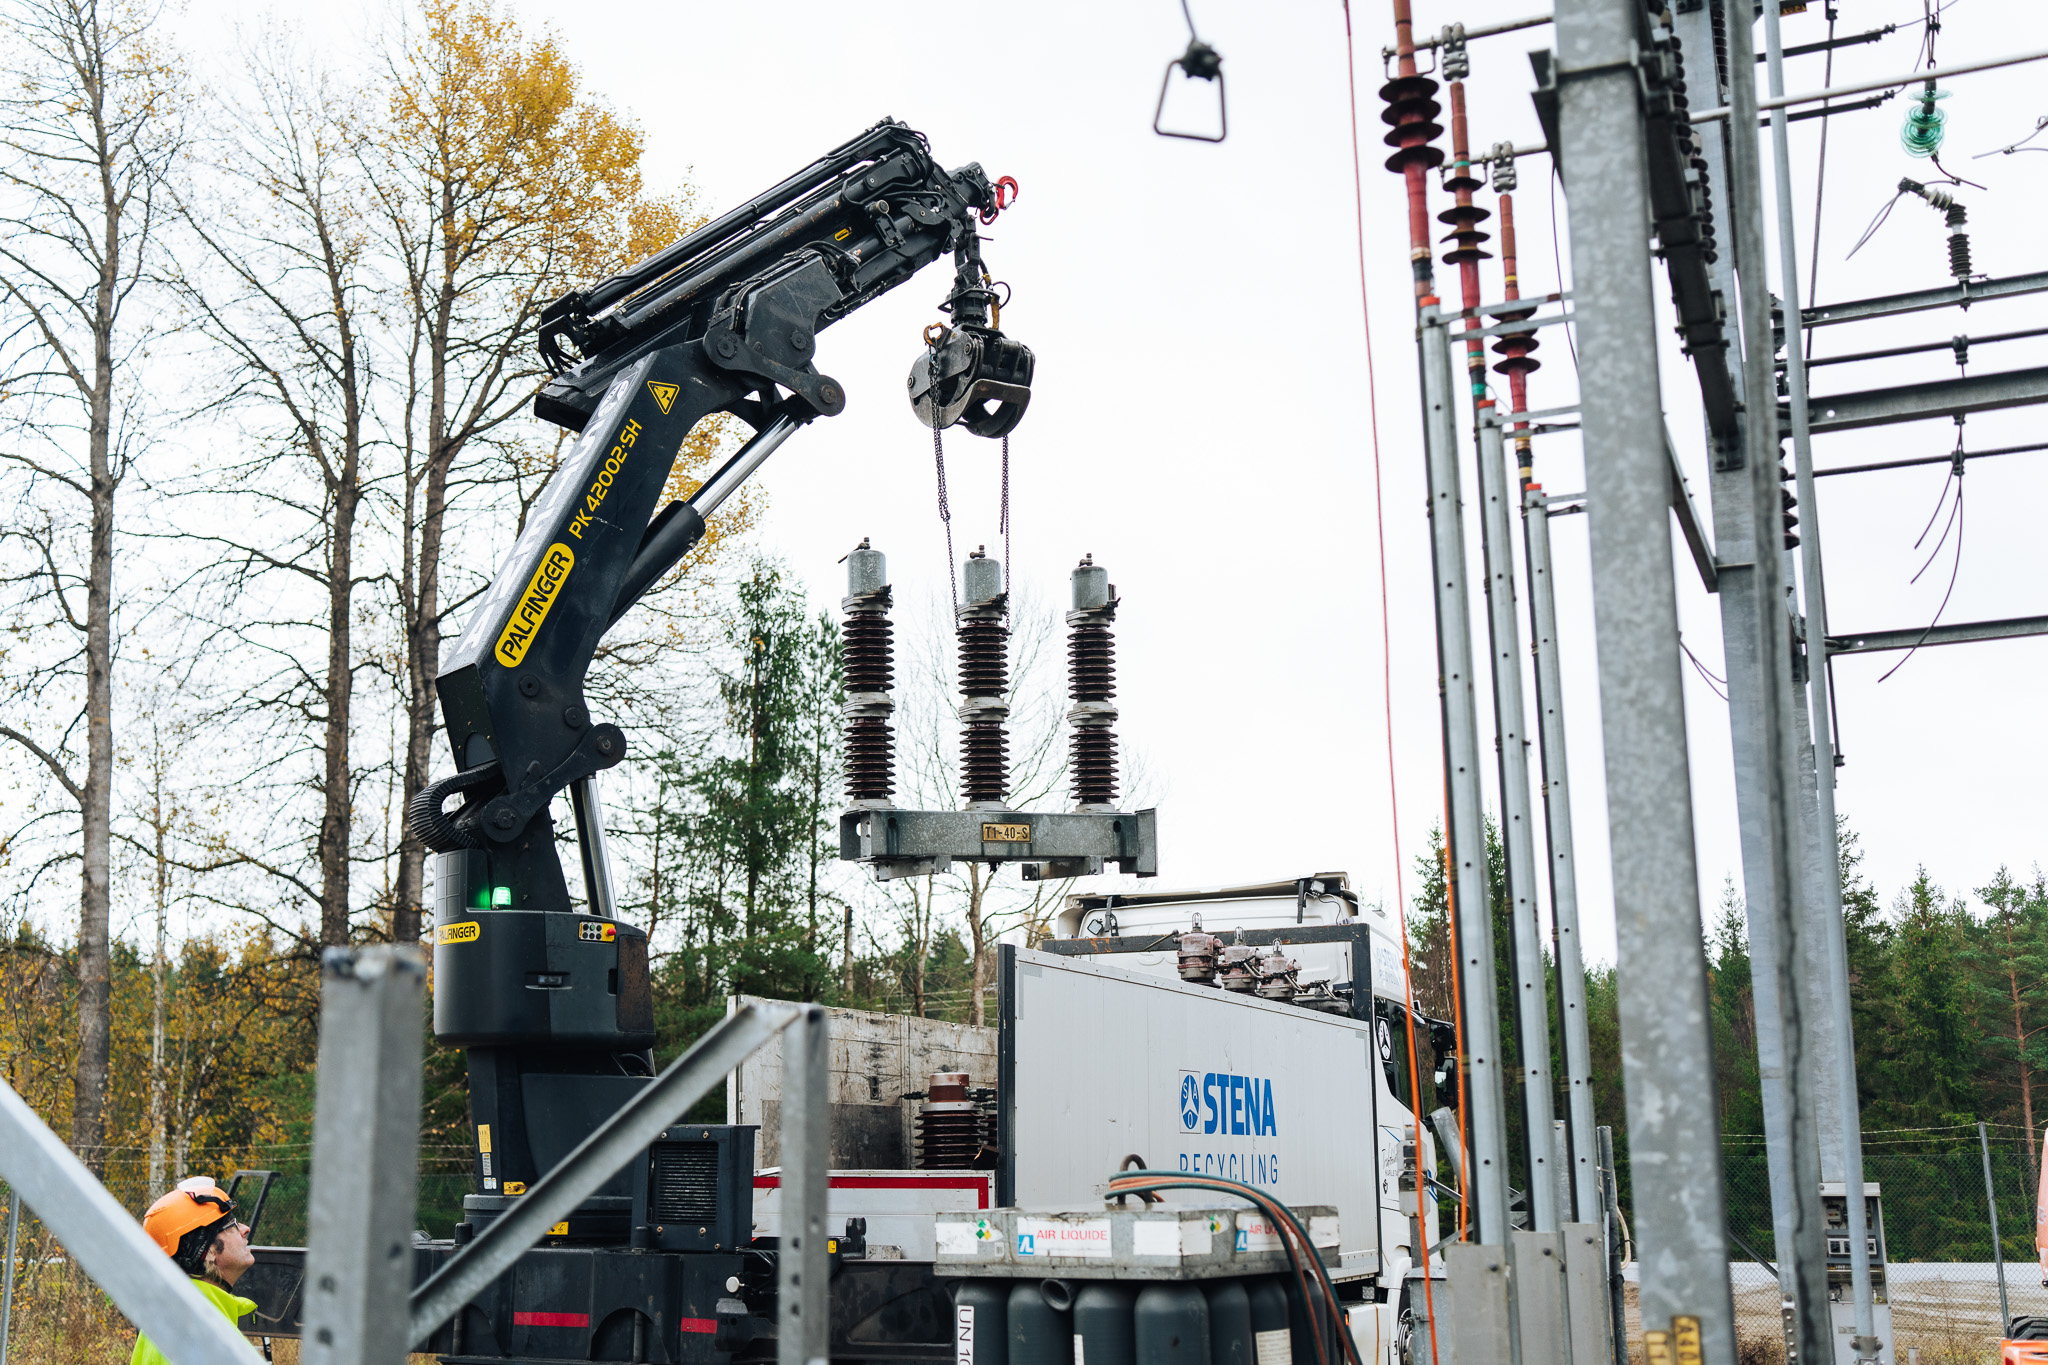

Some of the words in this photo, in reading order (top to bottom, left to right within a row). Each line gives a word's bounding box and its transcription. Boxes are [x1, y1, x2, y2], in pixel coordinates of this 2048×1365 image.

[568, 508, 594, 540] PK
[500, 550, 570, 662] PALFINGER
[985, 826, 1028, 839] T1-40-S
[439, 925, 476, 940] PALFINGER
[1203, 1072, 1277, 1137] STENA
[1179, 1153, 1278, 1184] RECYCLING
[1036, 1229, 1056, 1240] AIR
[1061, 1229, 1108, 1241] LIQUIDE
[1249, 1224, 1263, 1234] AIR
[959, 1309, 971, 1341] UN
